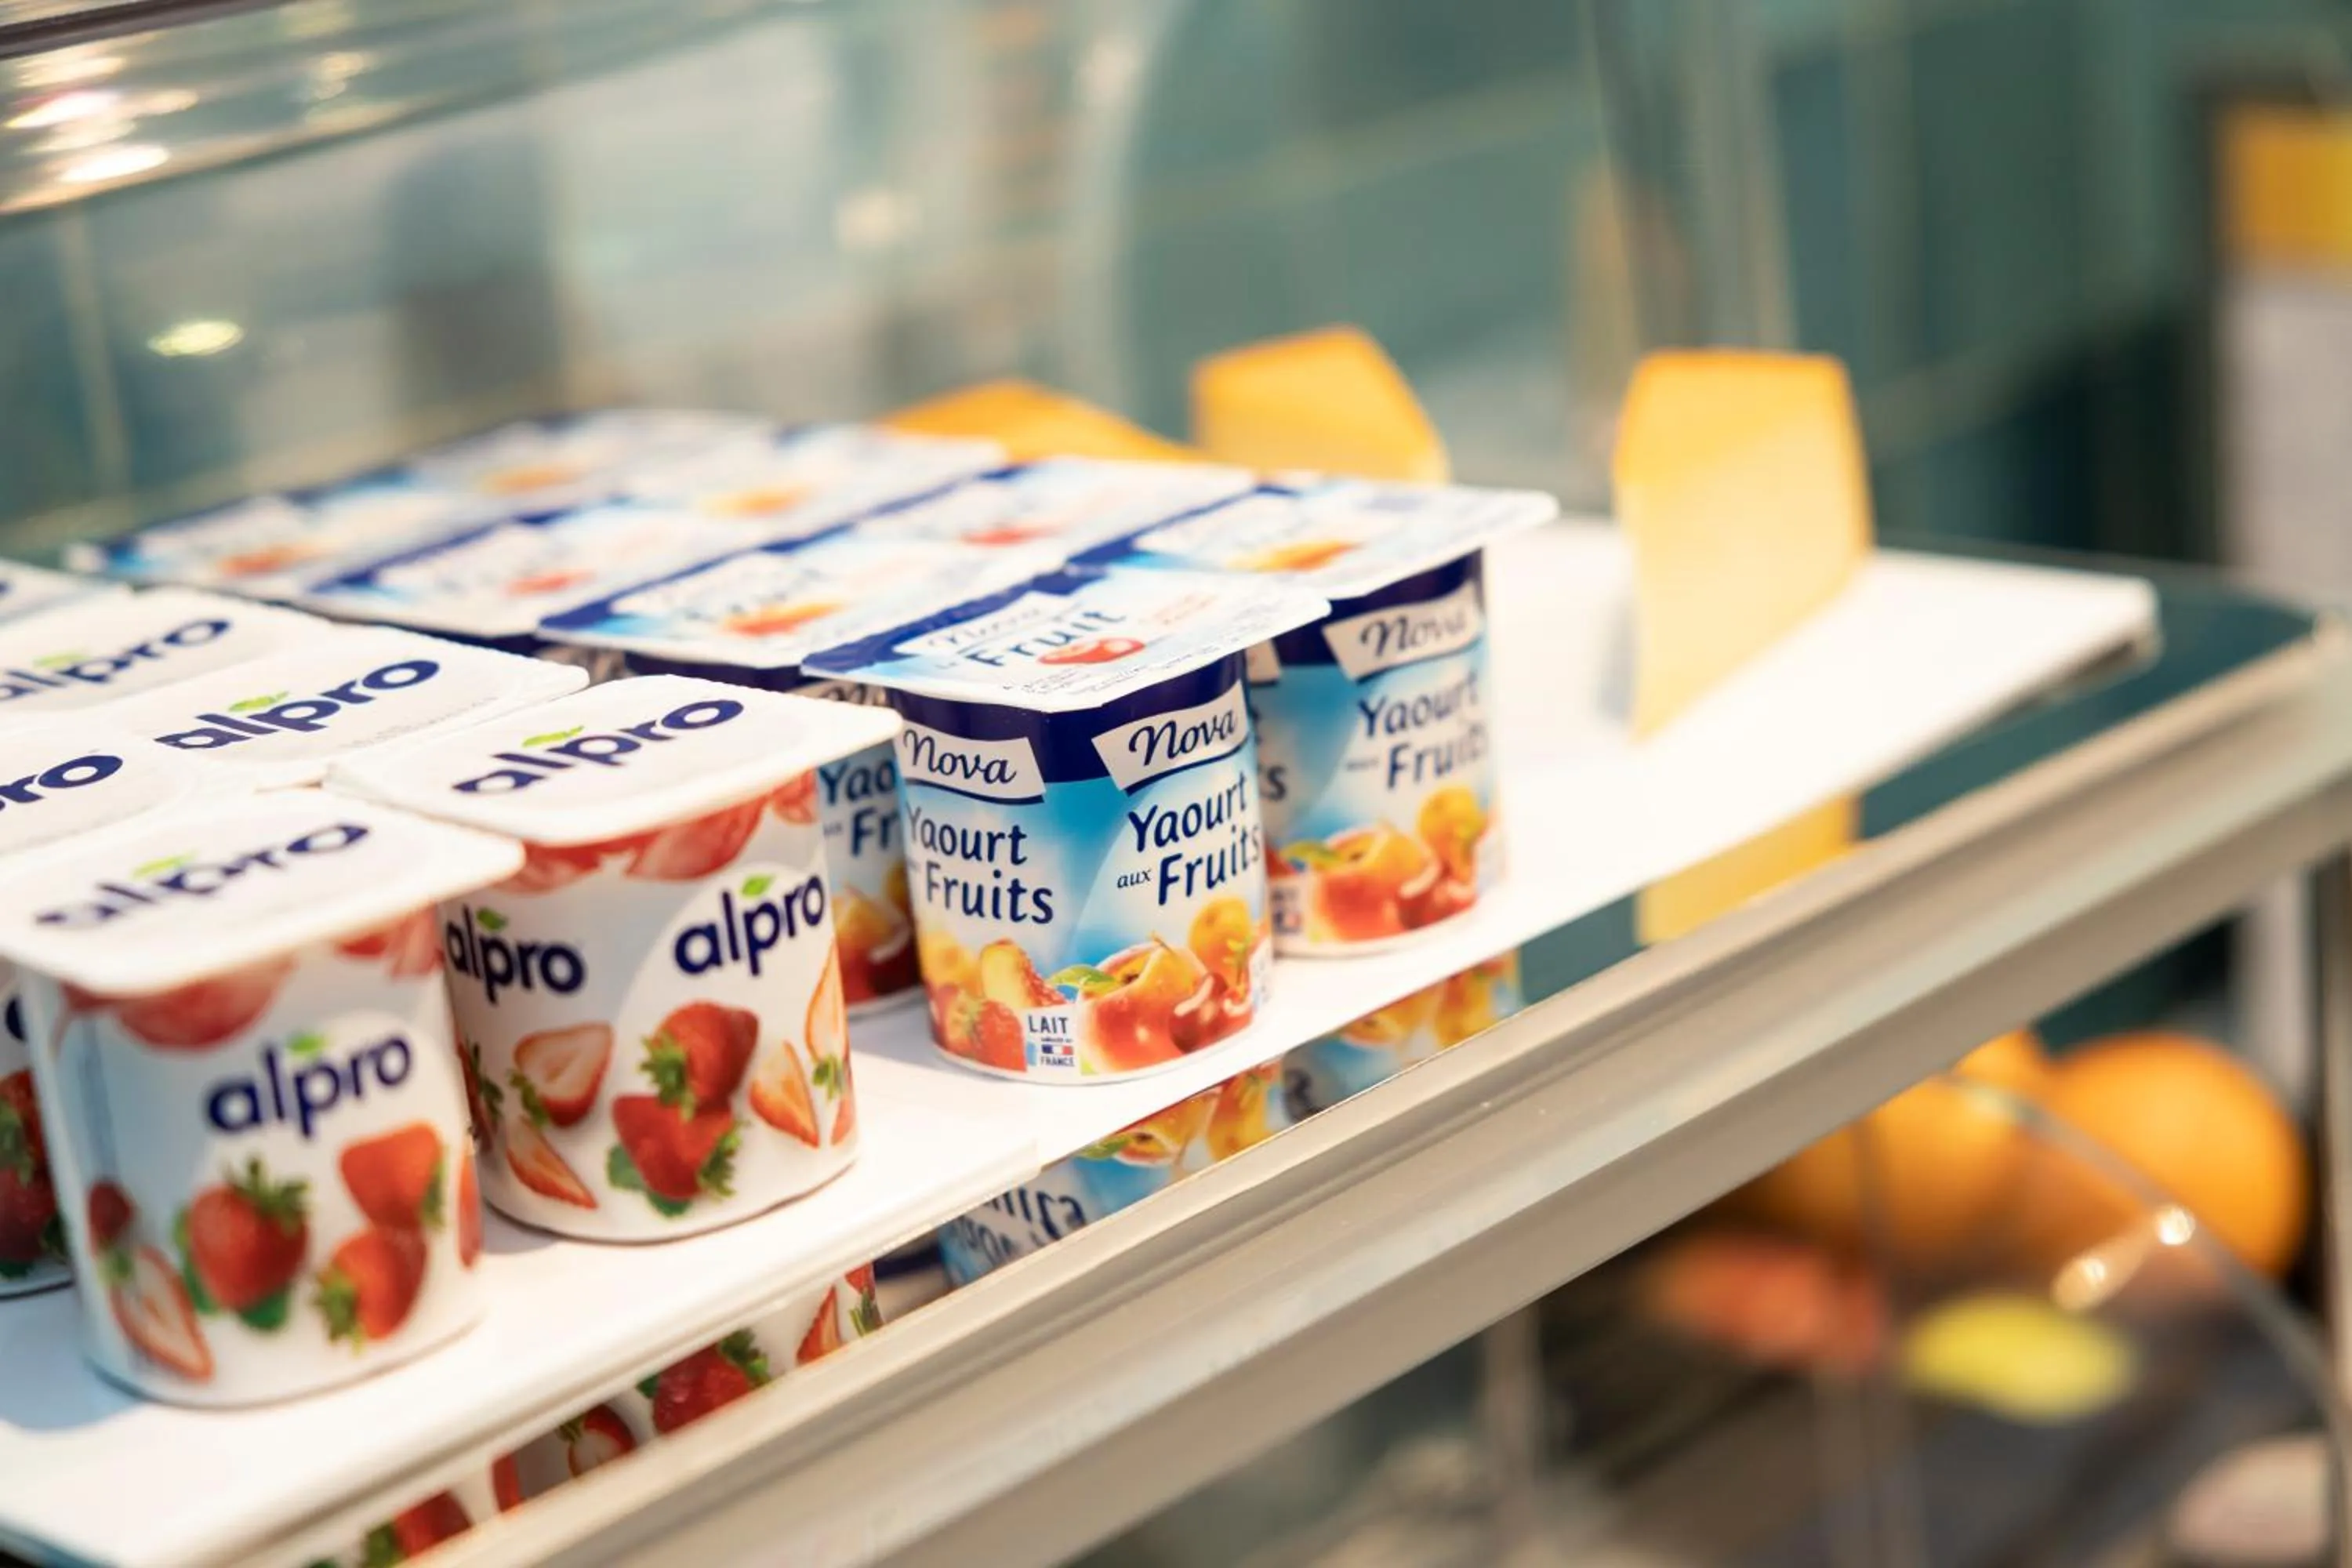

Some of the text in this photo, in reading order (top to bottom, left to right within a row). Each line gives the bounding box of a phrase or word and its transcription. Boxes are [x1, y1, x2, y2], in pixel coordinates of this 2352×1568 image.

[154, 659, 440, 750] alpro
[1128, 709, 1234, 766] Nova
[1356, 669, 1479, 737] Yaourt
[450, 700, 744, 793] alpro
[818, 759, 896, 807] Yao
[904, 729, 1017, 784] Nova
[906, 800, 1028, 866] Yaourt
[1127, 771, 1247, 853] Yaourt
[33, 823, 369, 928] alpro
[926, 860, 1053, 924] Fruits
[1116, 826, 1259, 906] aux Fruits
[445, 906, 586, 1005] alpro
[673, 875, 825, 975] alpro
[1028, 1014, 1068, 1034] LAIT
[204, 1035, 412, 1138] alpro
[1040, 1056, 1074, 1067] FRANCE
